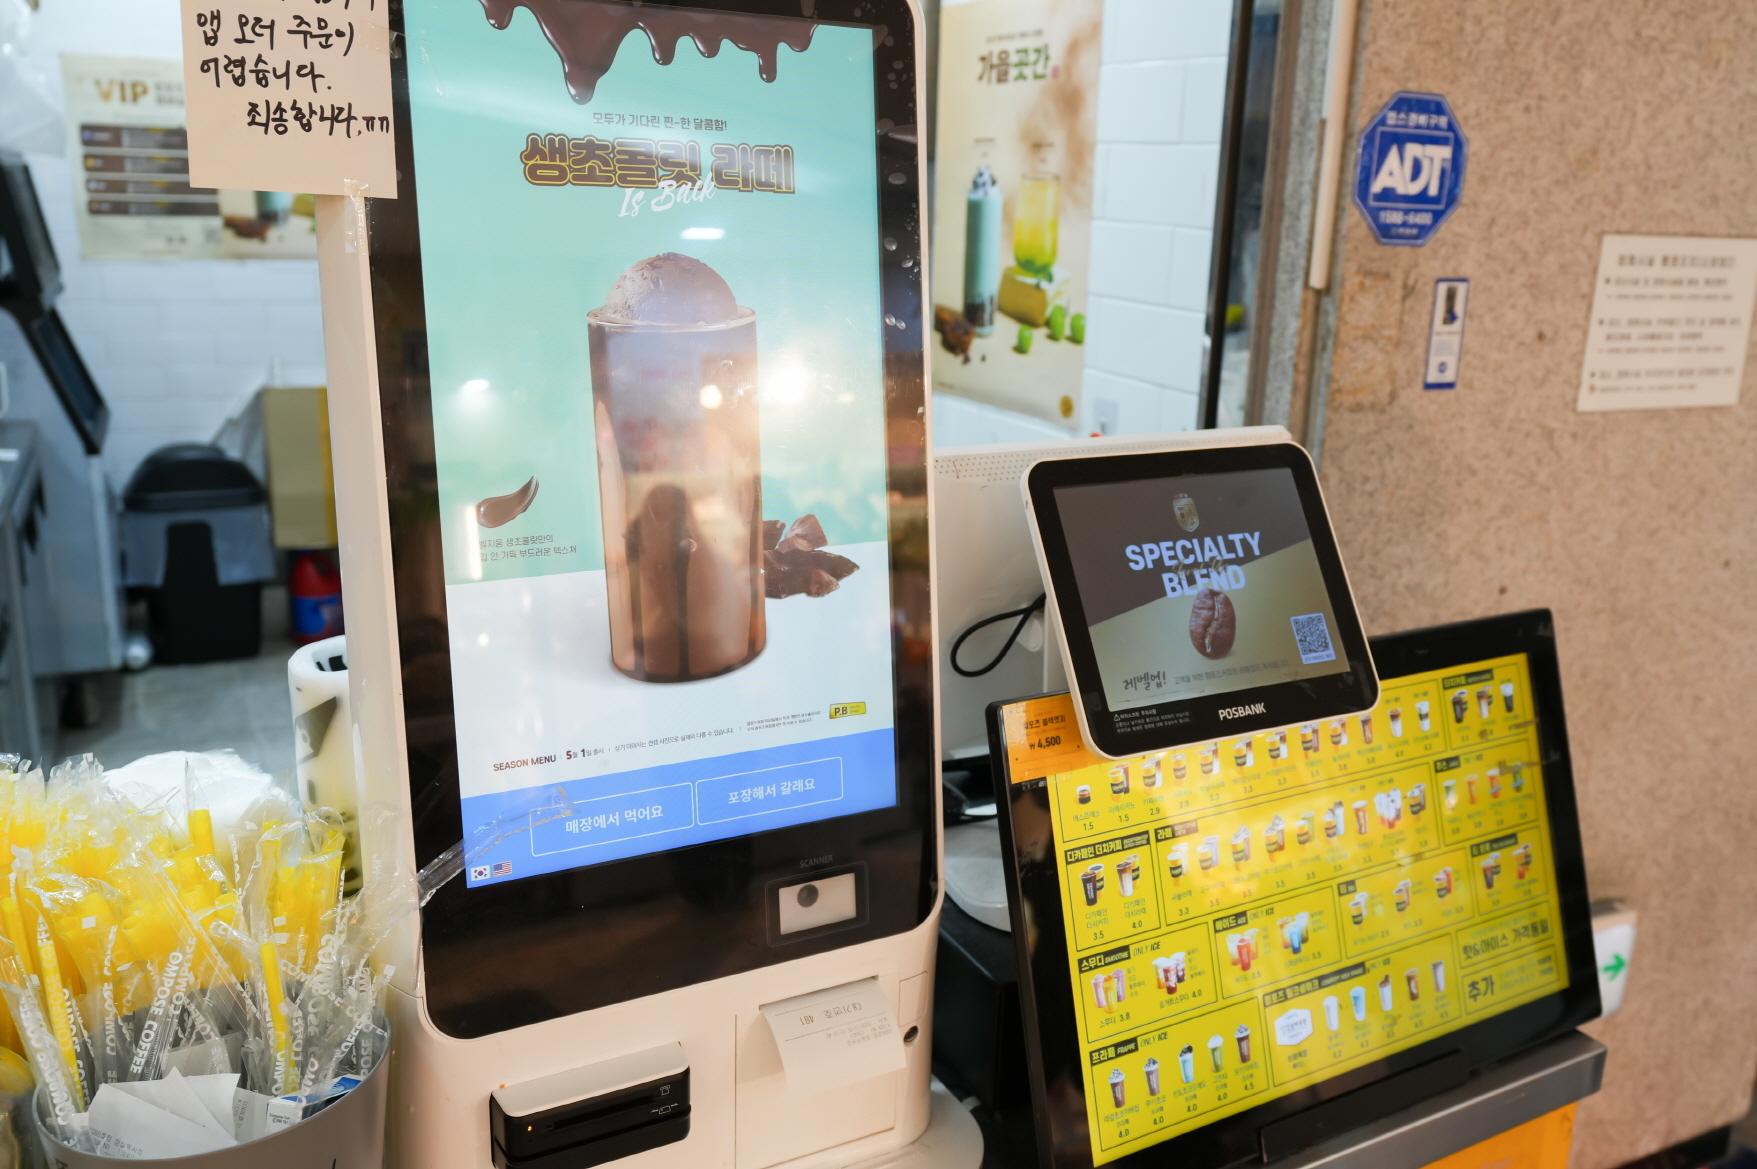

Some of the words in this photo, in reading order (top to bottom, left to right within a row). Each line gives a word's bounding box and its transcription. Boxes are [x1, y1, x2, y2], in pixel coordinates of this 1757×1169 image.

[196, 9, 221, 46] 앱
[286, 15, 354, 56] 주문이
[200, 53, 332, 93] 어렵습니다.
[94, 79, 149, 105] VIP
[592, 112, 626, 126] 모두가
[627, 114, 660, 128] 기다린
[693, 118, 728, 132] 달콤함!
[520, 132, 702, 190] 생초콜릿
[1370, 142, 1454, 197] ADT
[650, 172, 718, 211] Back
[1125, 531, 1262, 572] SPECIALTY
[1161, 564, 1246, 598] BLEND
[1218, 702, 1266, 721] POSBANK
[1037, 735, 1061, 750] 4,500
[493, 759, 529, 772] SEASON
[530, 754, 557, 767] MENU
[727, 786, 777, 805] 포장해서
[780, 778, 816, 797] 갈래요
[565, 810, 620, 834] 매장에서
[624, 804, 664, 824] 먹어요
[1083, 822, 1094, 831] 1.5
[1118, 814, 1130, 823] 1.5
[799, 854, 834, 869] SCANNER
[1093, 930, 1104, 941] 3.5
[1132, 920, 1143, 929] 4.0
[1081, 954, 1105, 971] 스무디
[1150, 942, 1160, 951] ICE
[1467, 973, 1495, 1002] 추가
[130, 1020, 158, 1075] COFFEE
[1217, 1092, 1228, 1101] 4.0
[1186, 1104, 1198, 1113] 4.0
[1152, 1116, 1164, 1126] 4.0
[1118, 1128, 1130, 1138] 4.0
